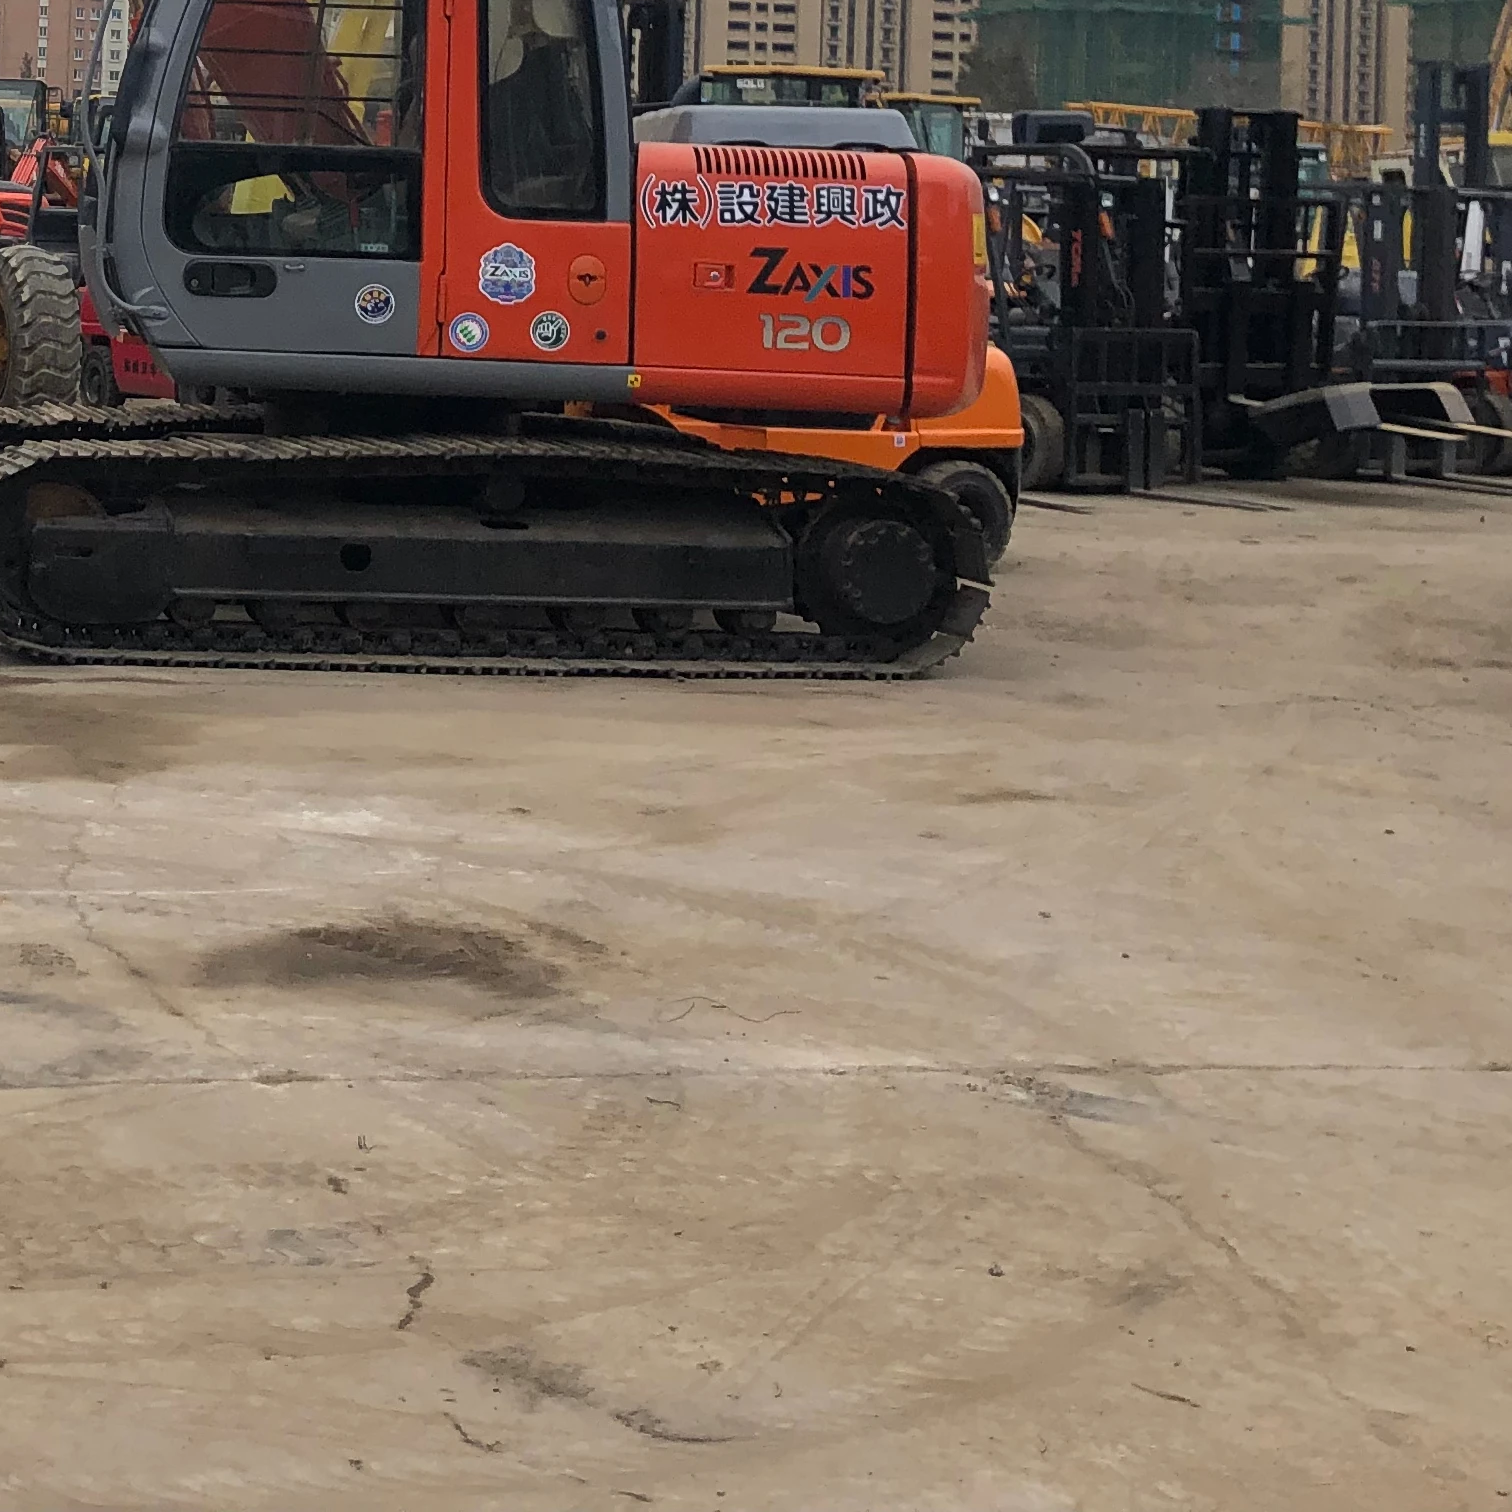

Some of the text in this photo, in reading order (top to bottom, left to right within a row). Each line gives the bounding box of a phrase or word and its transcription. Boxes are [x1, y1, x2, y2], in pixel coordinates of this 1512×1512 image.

[488, 265, 529, 279] ZAXIS
[745, 247, 876, 303] ZAXIS
[759, 313, 851, 353] 120
